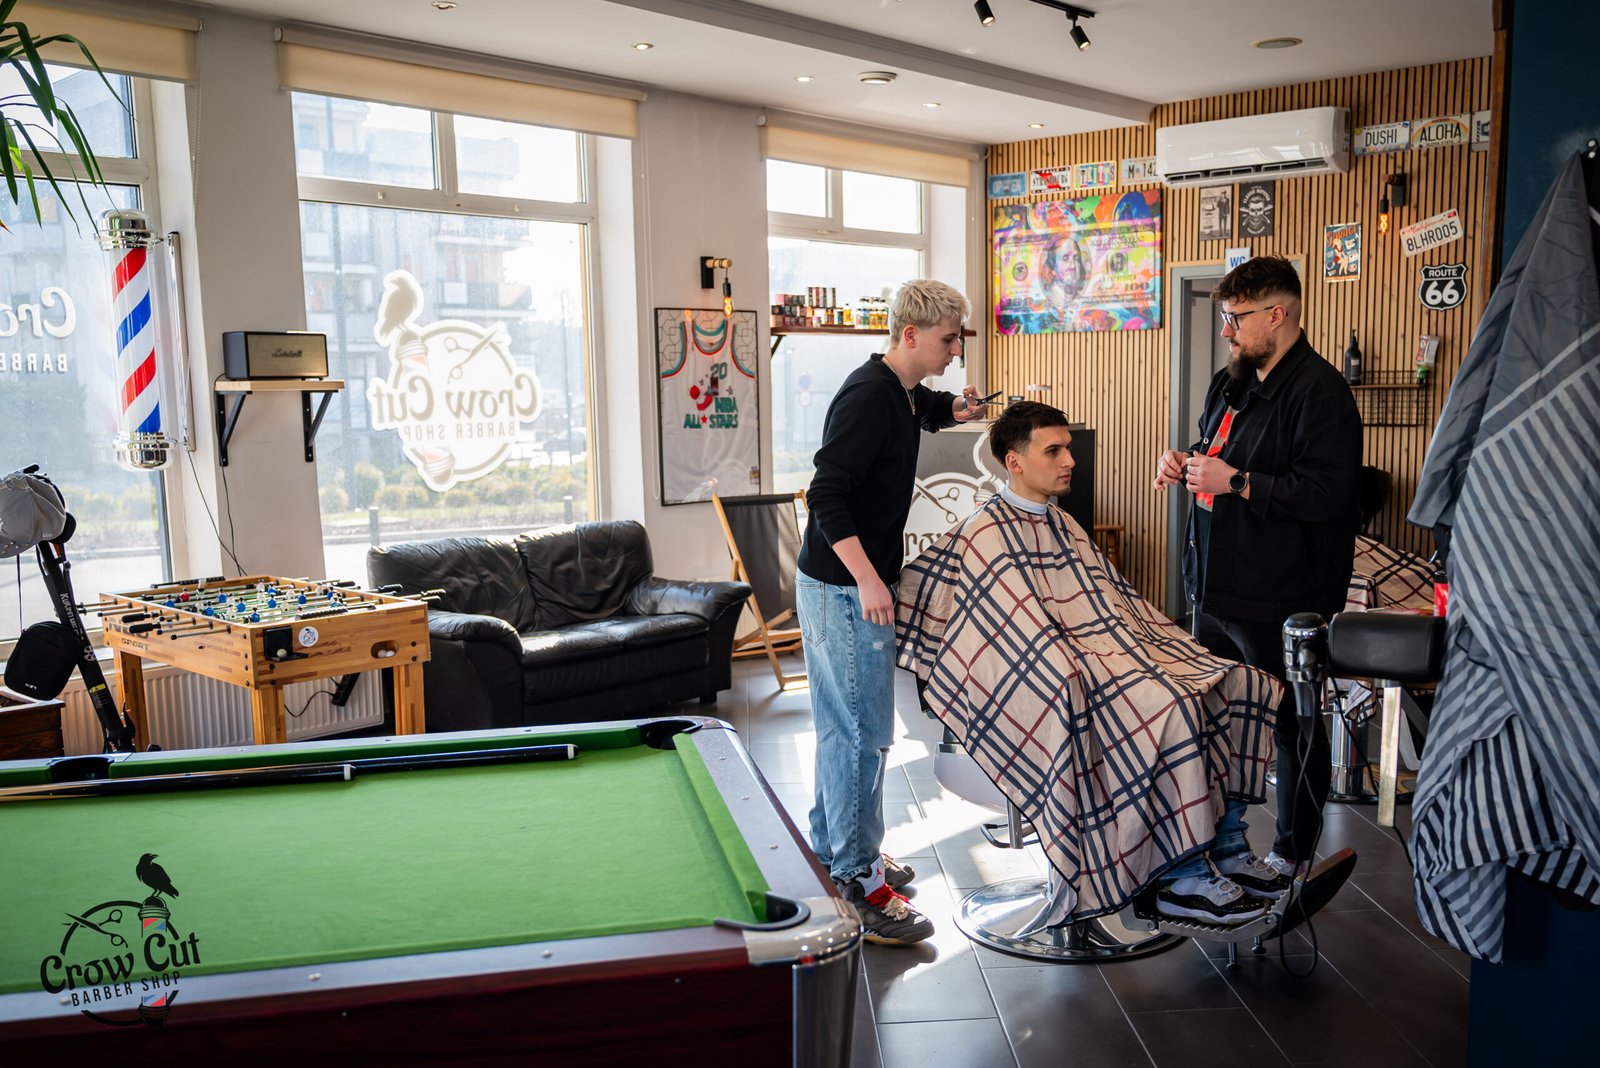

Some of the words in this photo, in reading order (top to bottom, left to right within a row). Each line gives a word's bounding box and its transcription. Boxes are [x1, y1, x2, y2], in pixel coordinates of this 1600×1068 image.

[1365, 129, 1397, 147] DUSHI
[1420, 121, 1461, 142] ALOHA
[1406, 221, 1458, 252] 8LHR005
[1428, 269, 1458, 278] ROUTE
[1425, 279, 1460, 306] 66
[710, 362, 727, 380] 20
[714, 397, 739, 414] NBA
[121, 638, 150, 650] SPORT
